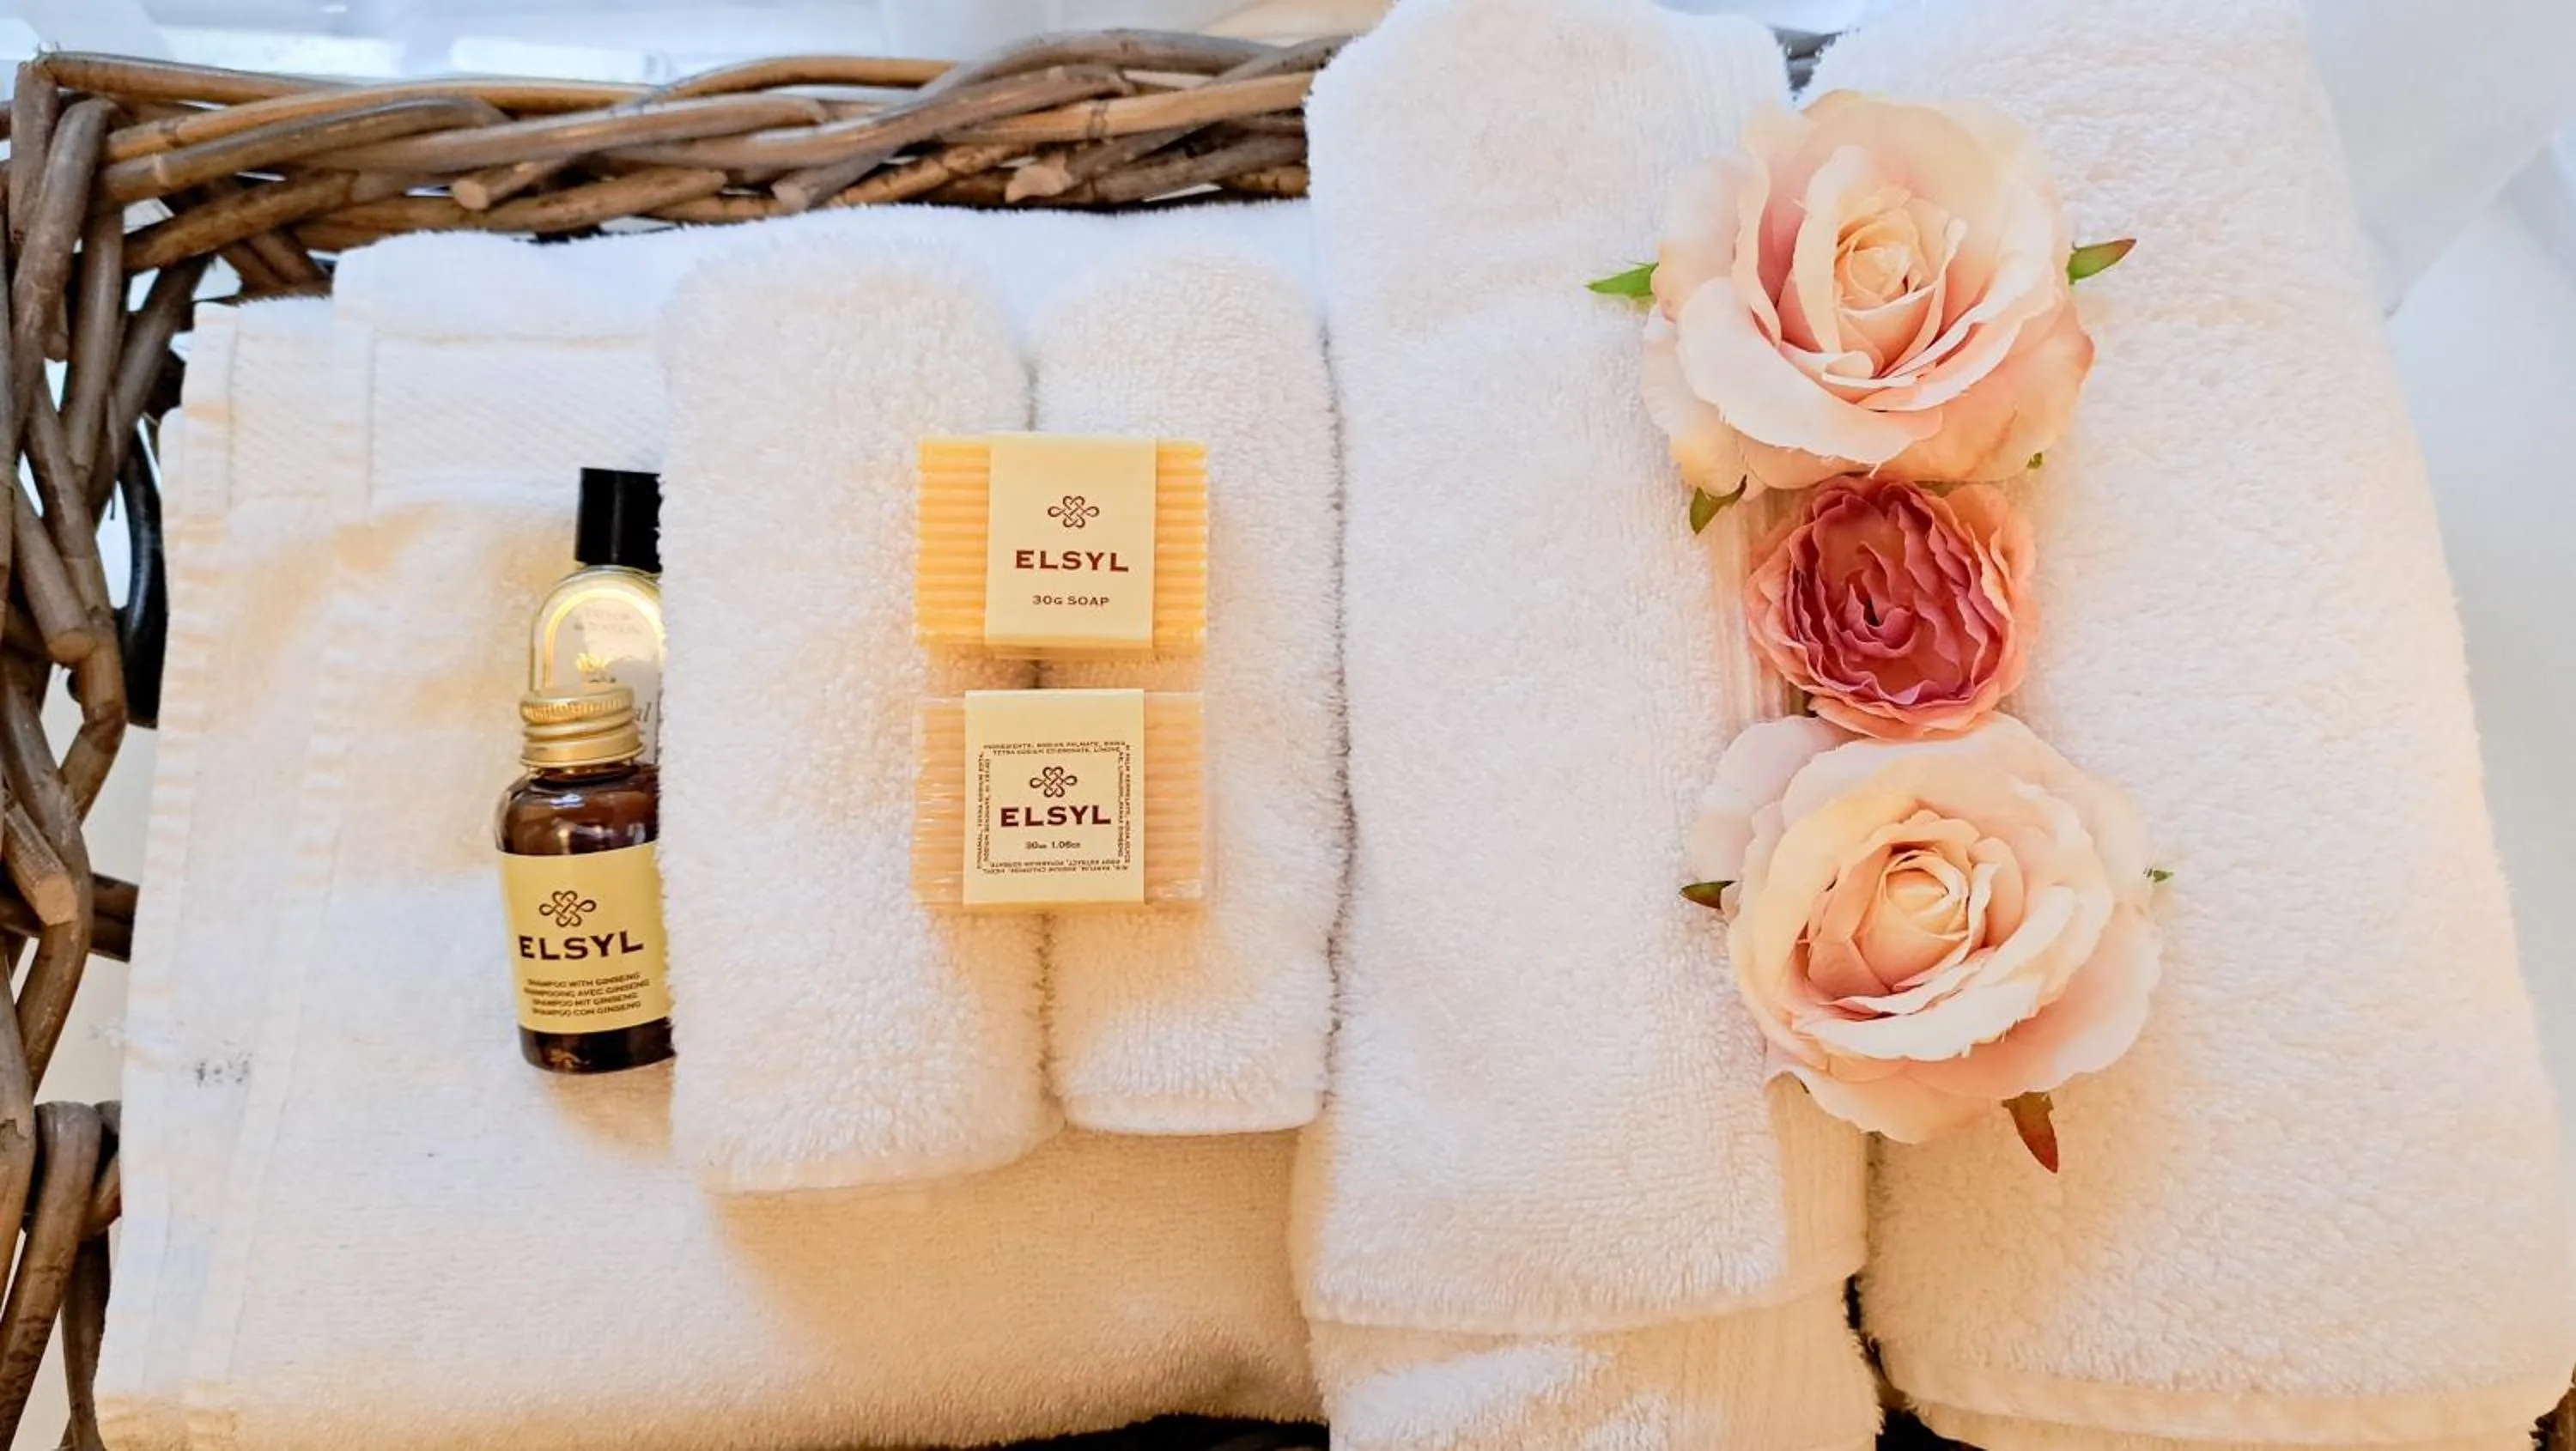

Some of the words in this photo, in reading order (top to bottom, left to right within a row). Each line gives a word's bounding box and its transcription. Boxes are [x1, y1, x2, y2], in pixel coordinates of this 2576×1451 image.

[1016, 549, 1129, 573] ELSYL
[1066, 594, 1111, 607] SOAP
[999, 804, 1112, 828] ELSYL
[519, 930, 645, 961] ELSYL
[569, 979, 593, 987] WITH
[578, 987, 605, 998] AVEC
